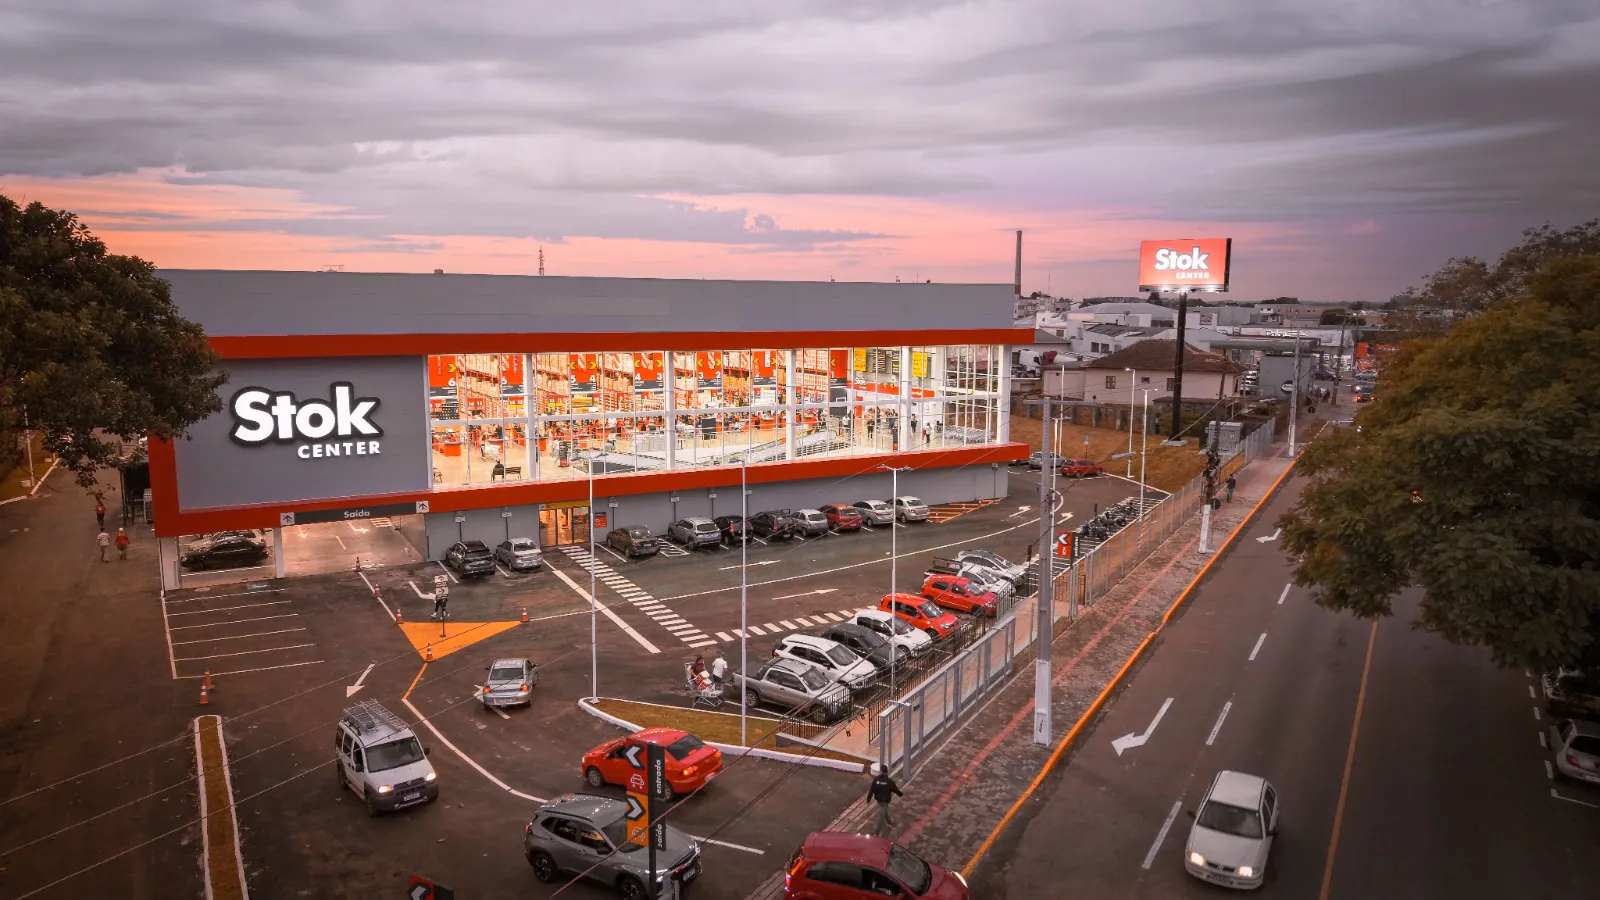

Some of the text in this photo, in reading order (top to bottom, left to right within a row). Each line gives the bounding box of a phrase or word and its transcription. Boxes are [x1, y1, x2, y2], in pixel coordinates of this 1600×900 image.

[1154, 246, 1209, 270] Stok
[589, 374, 596, 382] 4
[656, 372, 662, 380] 3
[698, 371, 704, 379] 3
[715, 371, 721, 379] 2
[448, 378, 456, 387] 6
[234, 386, 380, 442] Stok
[297, 441, 381, 459] CENTER
[343, 509, 371, 518] Saída
[654, 759, 662, 794] entrada
[654, 823, 663, 848] saída
